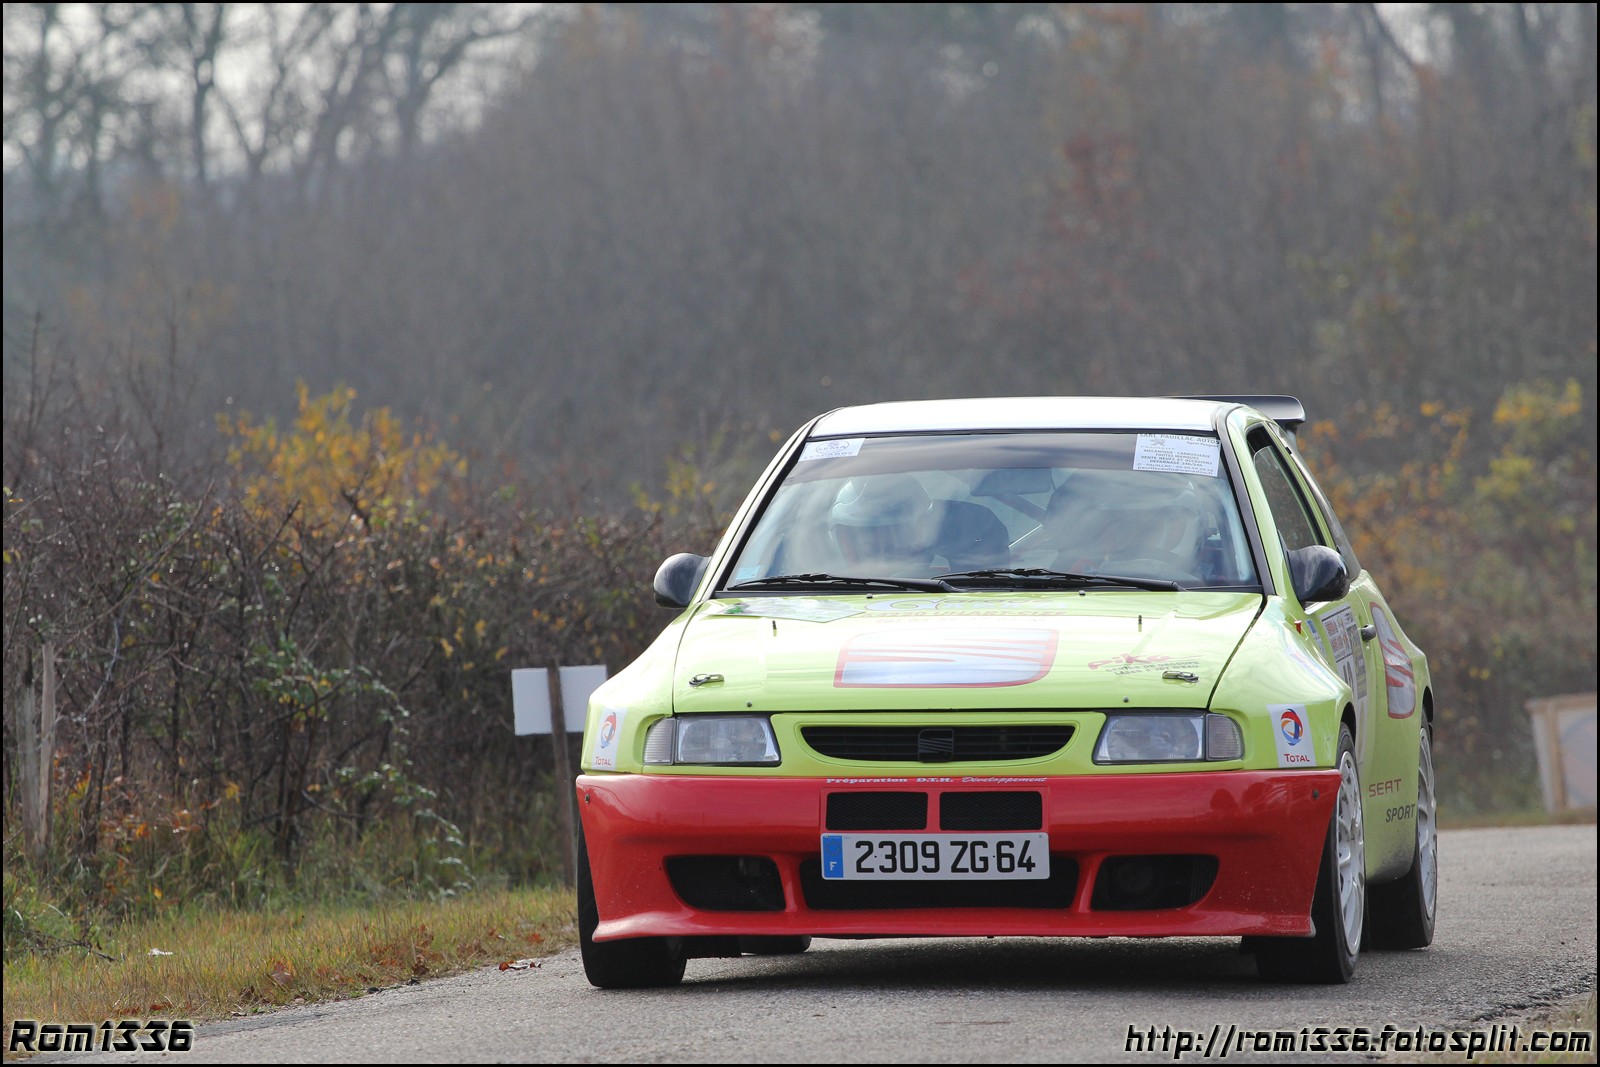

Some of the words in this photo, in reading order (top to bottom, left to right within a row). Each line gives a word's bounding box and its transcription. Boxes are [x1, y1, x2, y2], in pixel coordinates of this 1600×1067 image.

[1197, 437, 1219, 445] AUTOS
[1284, 753, 1310, 762] TOTAL
[1369, 778, 1402, 798] SEAT
[1385, 804, 1416, 823] SPORT
[829, 861, 837, 871] F
[855, 840, 940, 873] 2309
[949, 840, 989, 873] ZG
[996, 840, 1036, 873] 64
